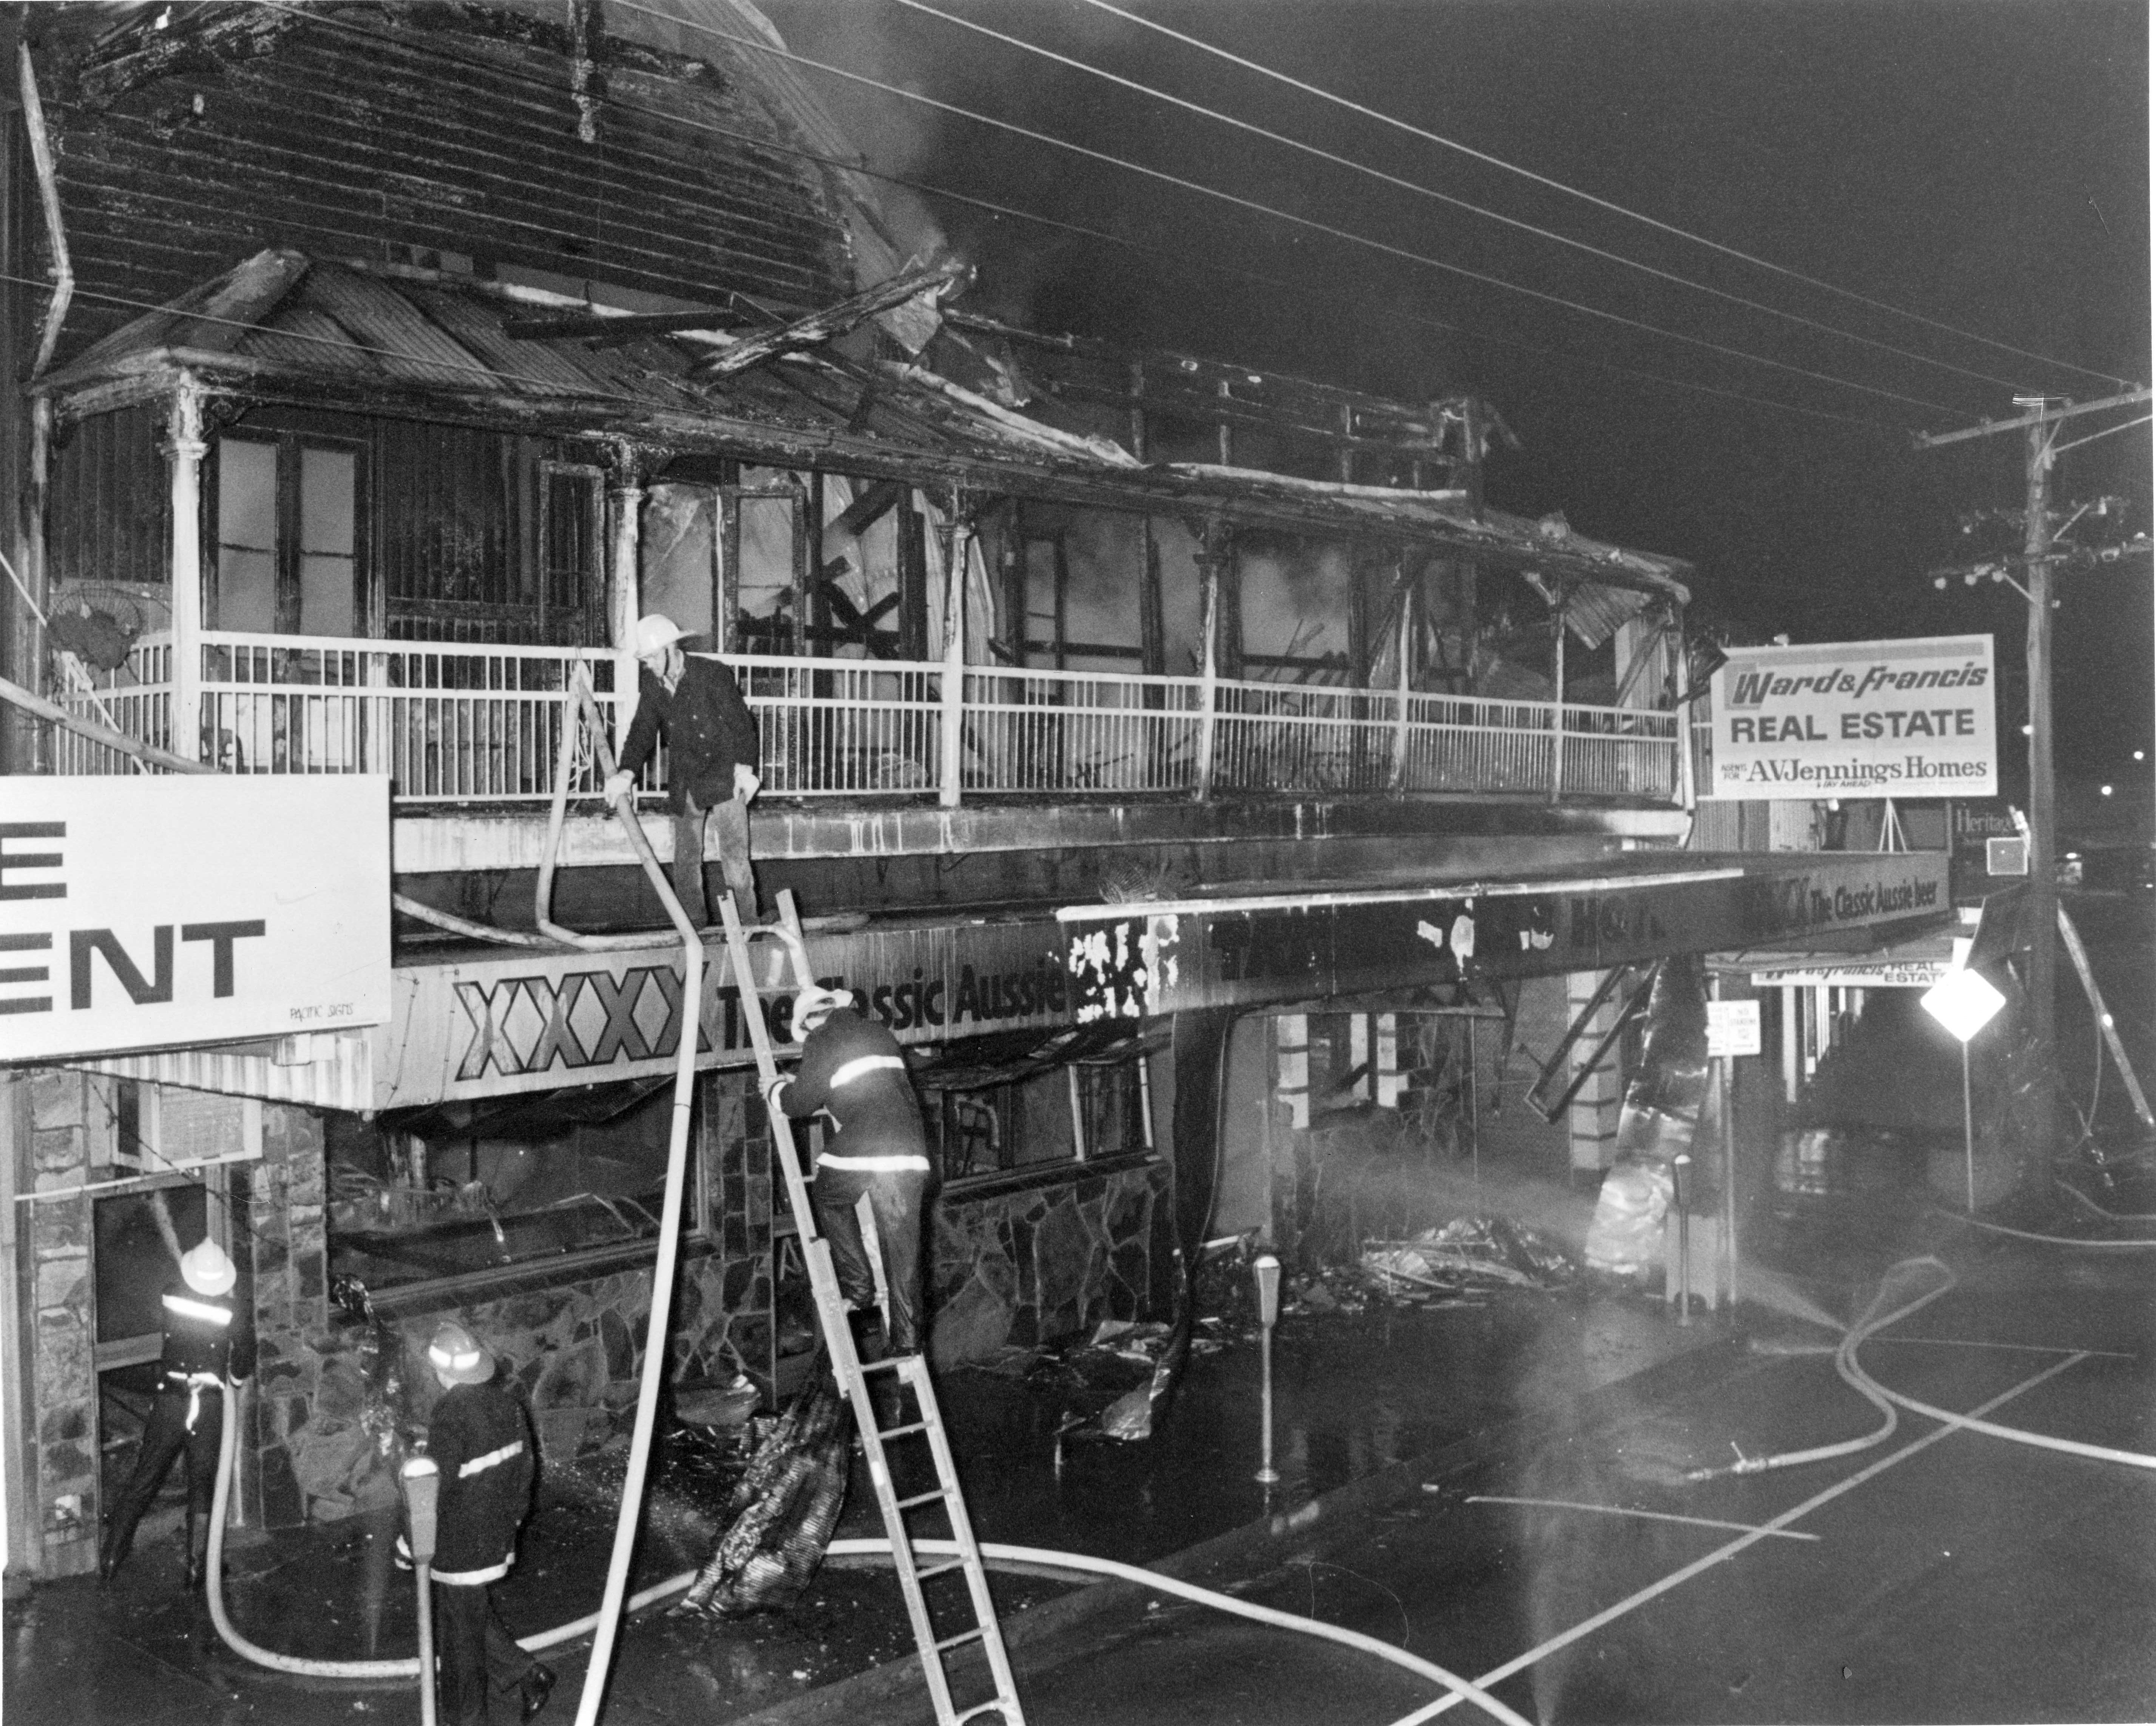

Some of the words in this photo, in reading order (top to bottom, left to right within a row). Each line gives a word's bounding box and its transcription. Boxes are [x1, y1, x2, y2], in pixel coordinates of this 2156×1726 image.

[1731, 715, 1828, 743] REAL
[1841, 709, 1975, 739] ESTATE
[1904, 755, 1988, 779] Homes
[1835, 883, 1876, 920] Classic
[1876, 878, 1913, 914] Aussie
[1914, 875, 1937, 908] beer
[1884, 971, 1946, 983] ESTAT
[289, 1005, 323, 1022] PACIFIC
[327, 1002, 354, 1018] SIGNS
[453, 961, 713, 1081] XXXX
[952, 957, 1067, 1024] Aussie
